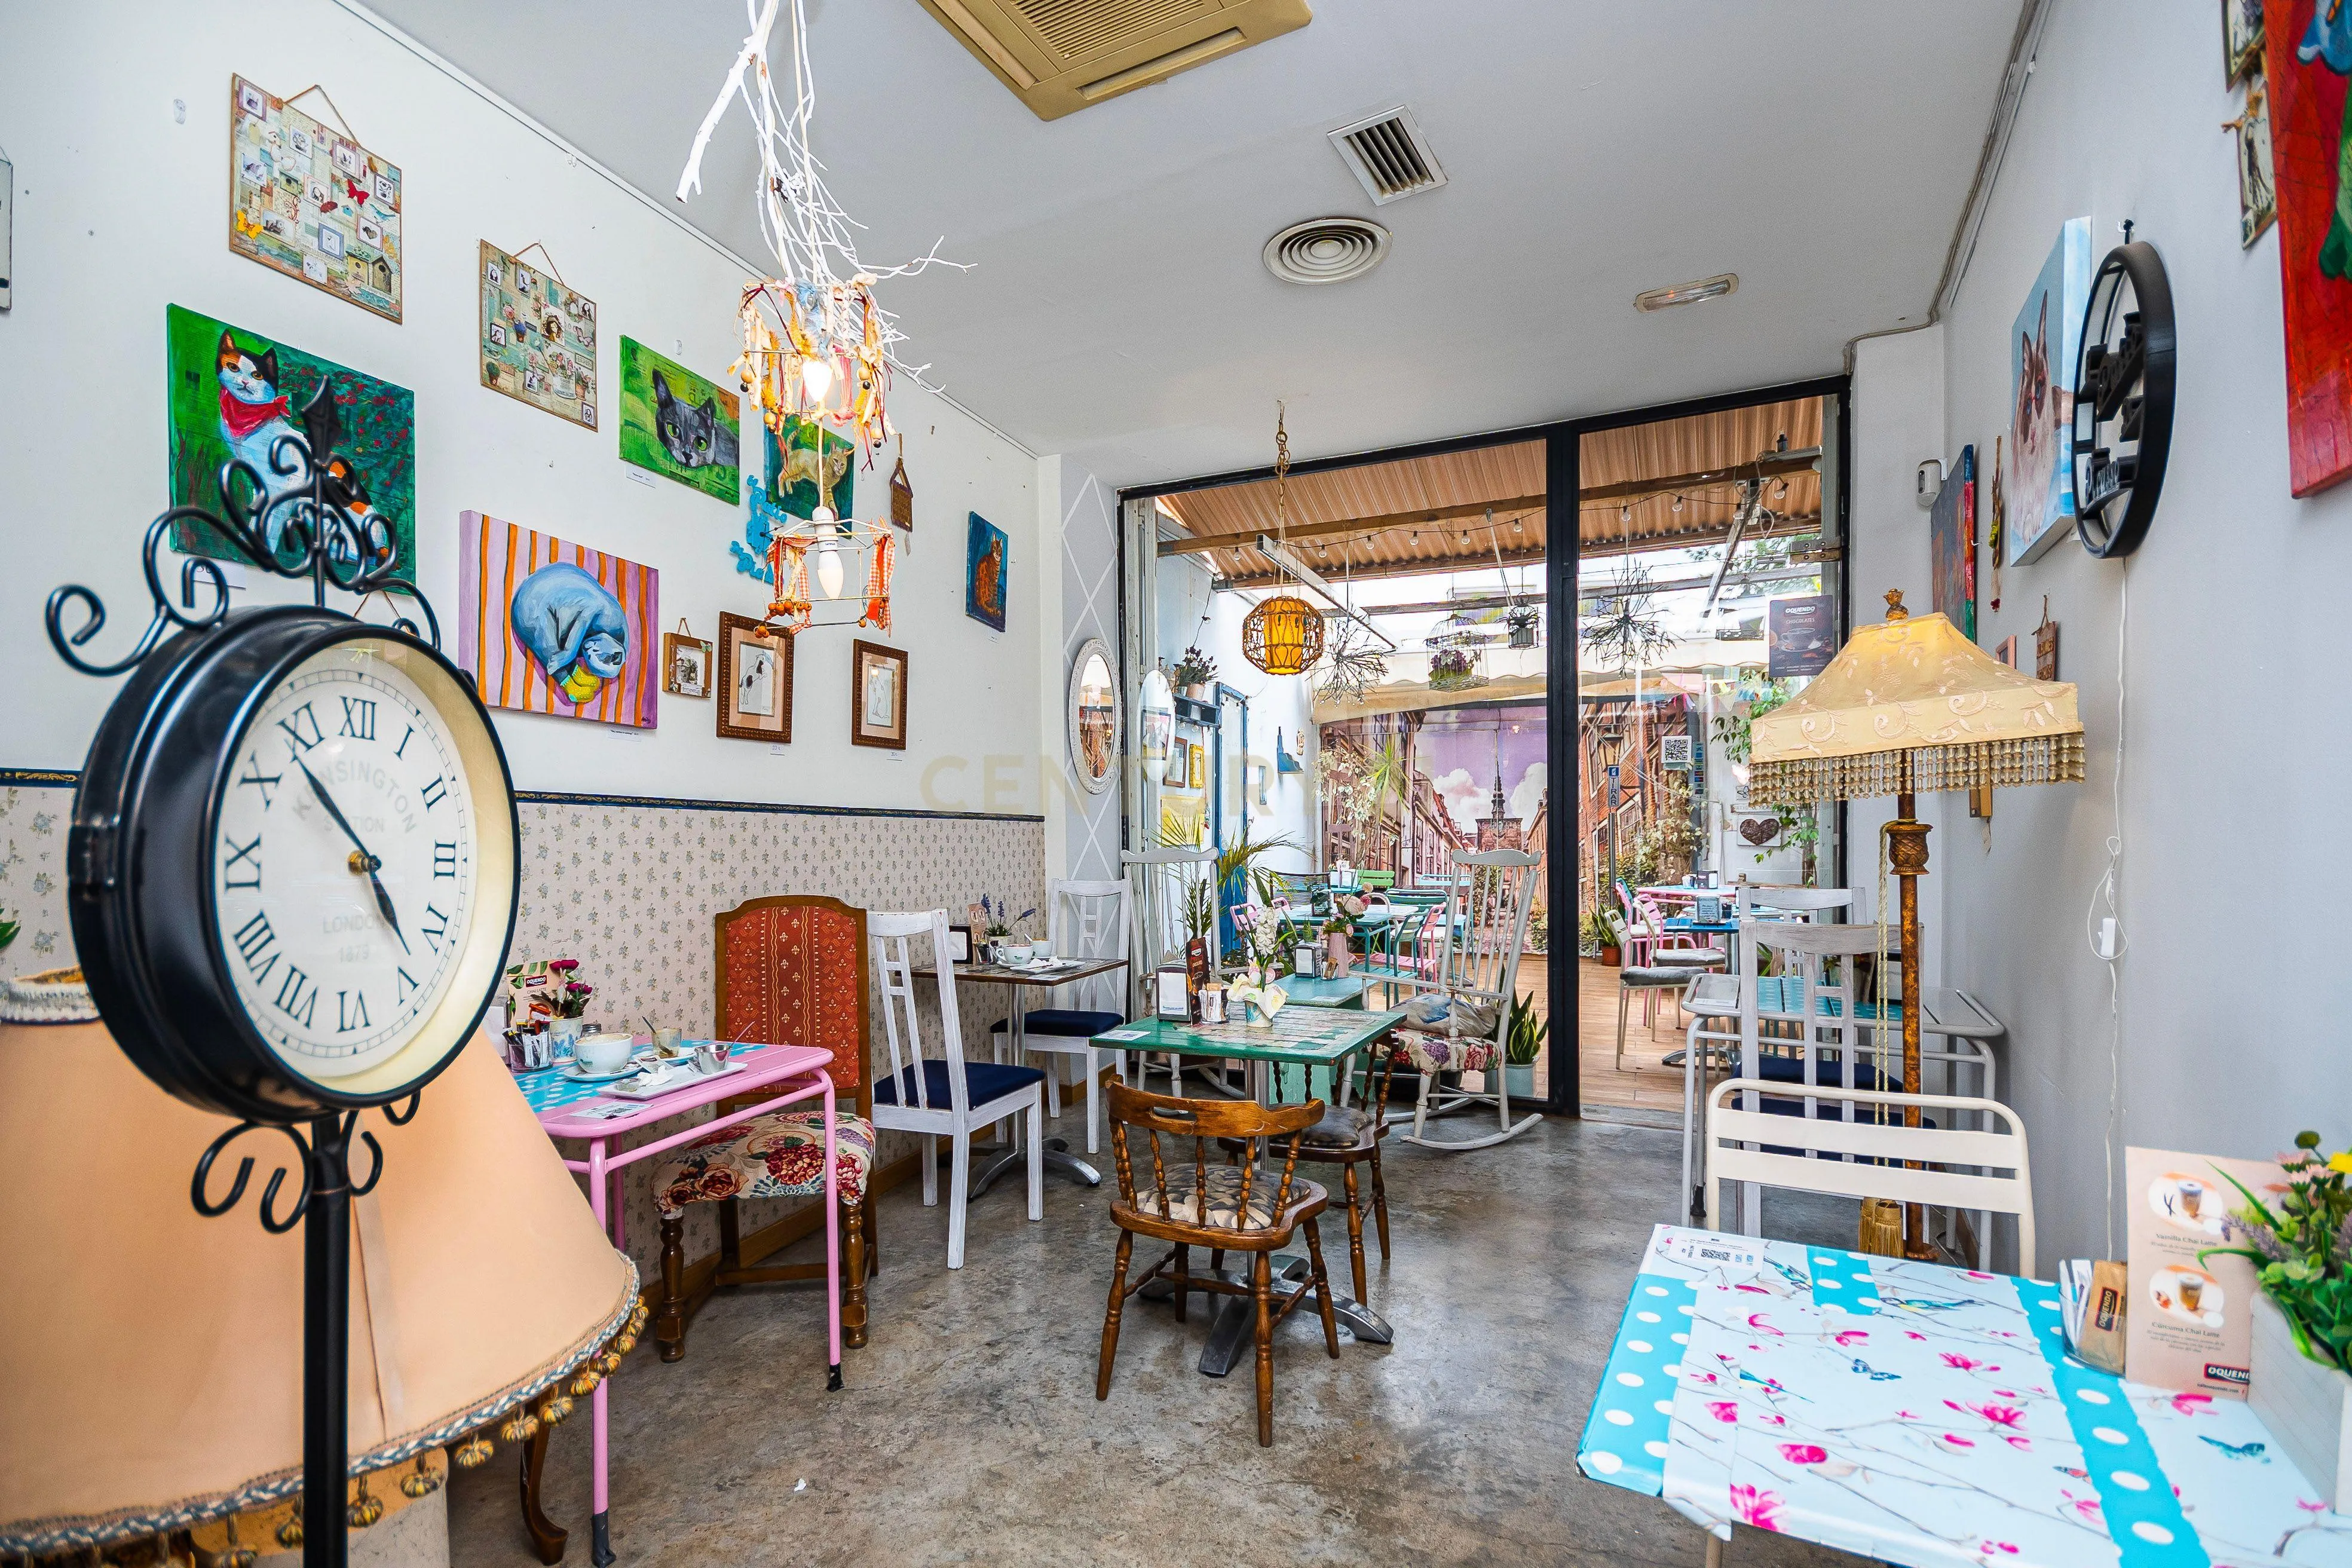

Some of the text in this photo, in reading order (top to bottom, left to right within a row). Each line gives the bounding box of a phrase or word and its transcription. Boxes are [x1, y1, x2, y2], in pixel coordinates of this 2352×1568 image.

[276, 700, 326, 764] XI
[338, 696, 377, 741] XII
[237, 751, 283, 811] X
[421, 773, 448, 813] II
[224, 832, 261, 892] IX
[433, 839, 457, 881] III
[232, 909, 283, 985] VIII
[421, 901, 448, 956] IV
[273, 963, 320, 1030] VII
[396, 965, 419, 1006] V
[336, 989, 371, 1033] VI
[2099, 1290, 2112, 1327] OQUENDO
